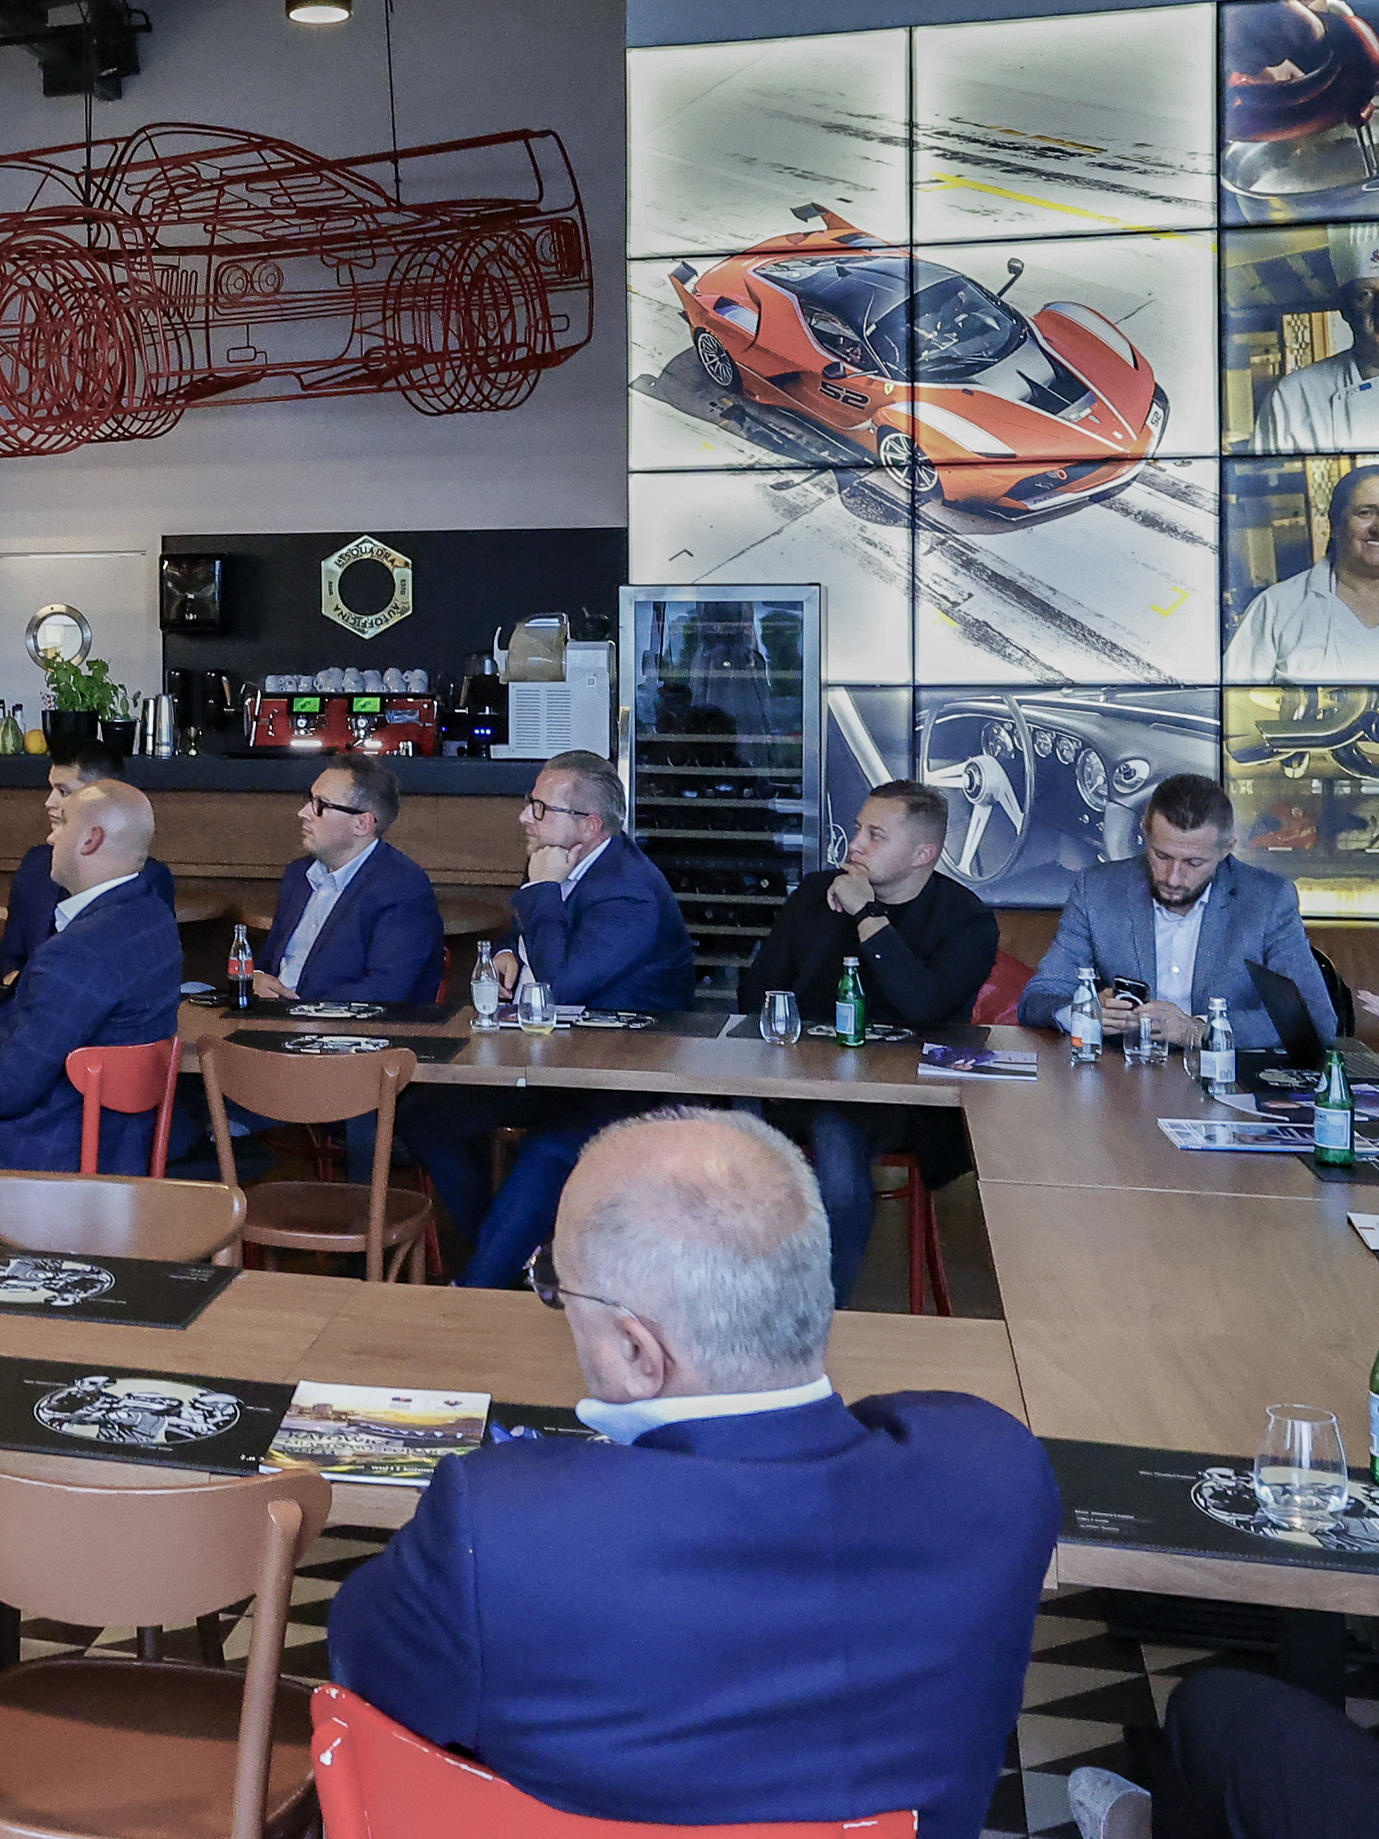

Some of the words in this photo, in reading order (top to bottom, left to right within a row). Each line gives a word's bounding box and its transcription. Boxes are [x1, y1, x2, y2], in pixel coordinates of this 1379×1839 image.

[819, 381, 870, 410] 52
[1150, 411, 1162, 428] 52
[333, 603, 400, 629] AUTOFFICINA
